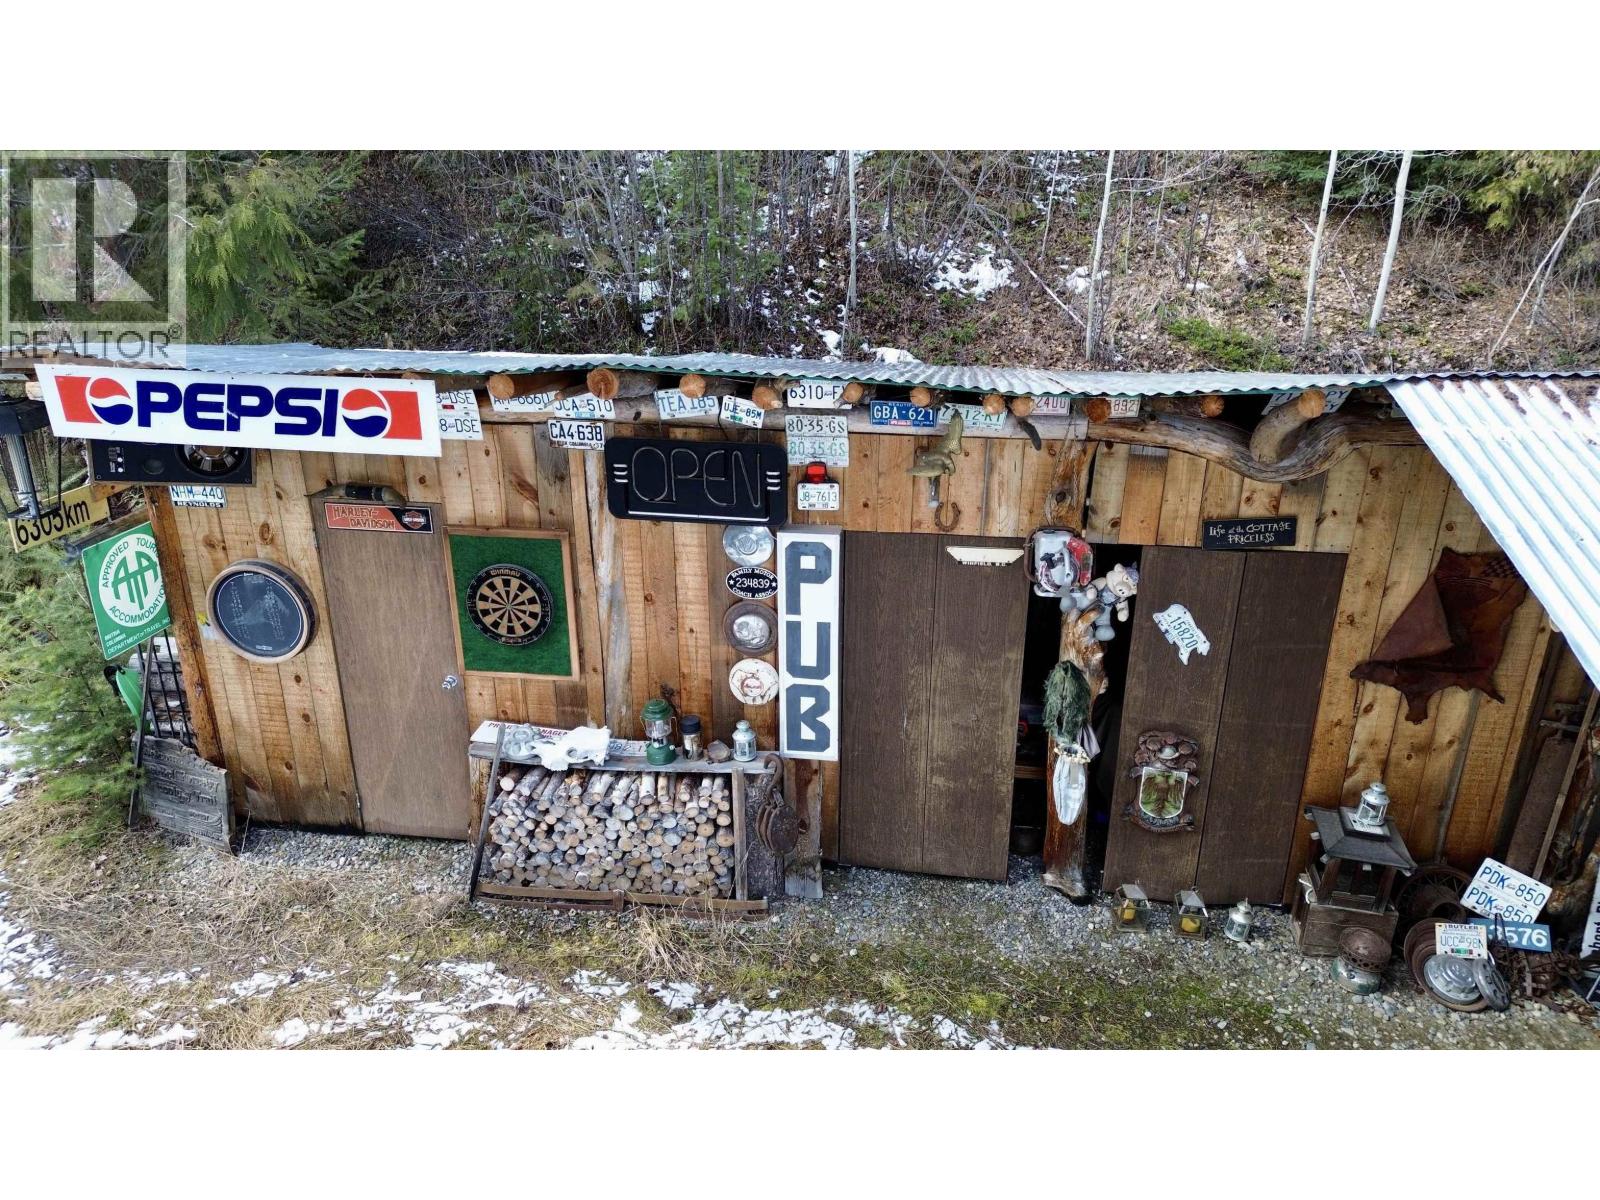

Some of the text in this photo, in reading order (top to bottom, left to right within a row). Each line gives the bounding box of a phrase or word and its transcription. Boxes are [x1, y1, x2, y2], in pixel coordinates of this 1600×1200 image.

[136, 380, 339, 437] PEPSI
[632, 446, 761, 508] OPEN
[349, 518, 396, 529] DAVIDSON
[102, 541, 129, 588] APPROVED
[731, 568, 774, 580] FAMILY MOTOR
[732, 587, 752, 599] COACH
[735, 577, 770, 589] 234839
[785, 541, 833, 753] PUB
[1169, 616, 1199, 649] 15820
